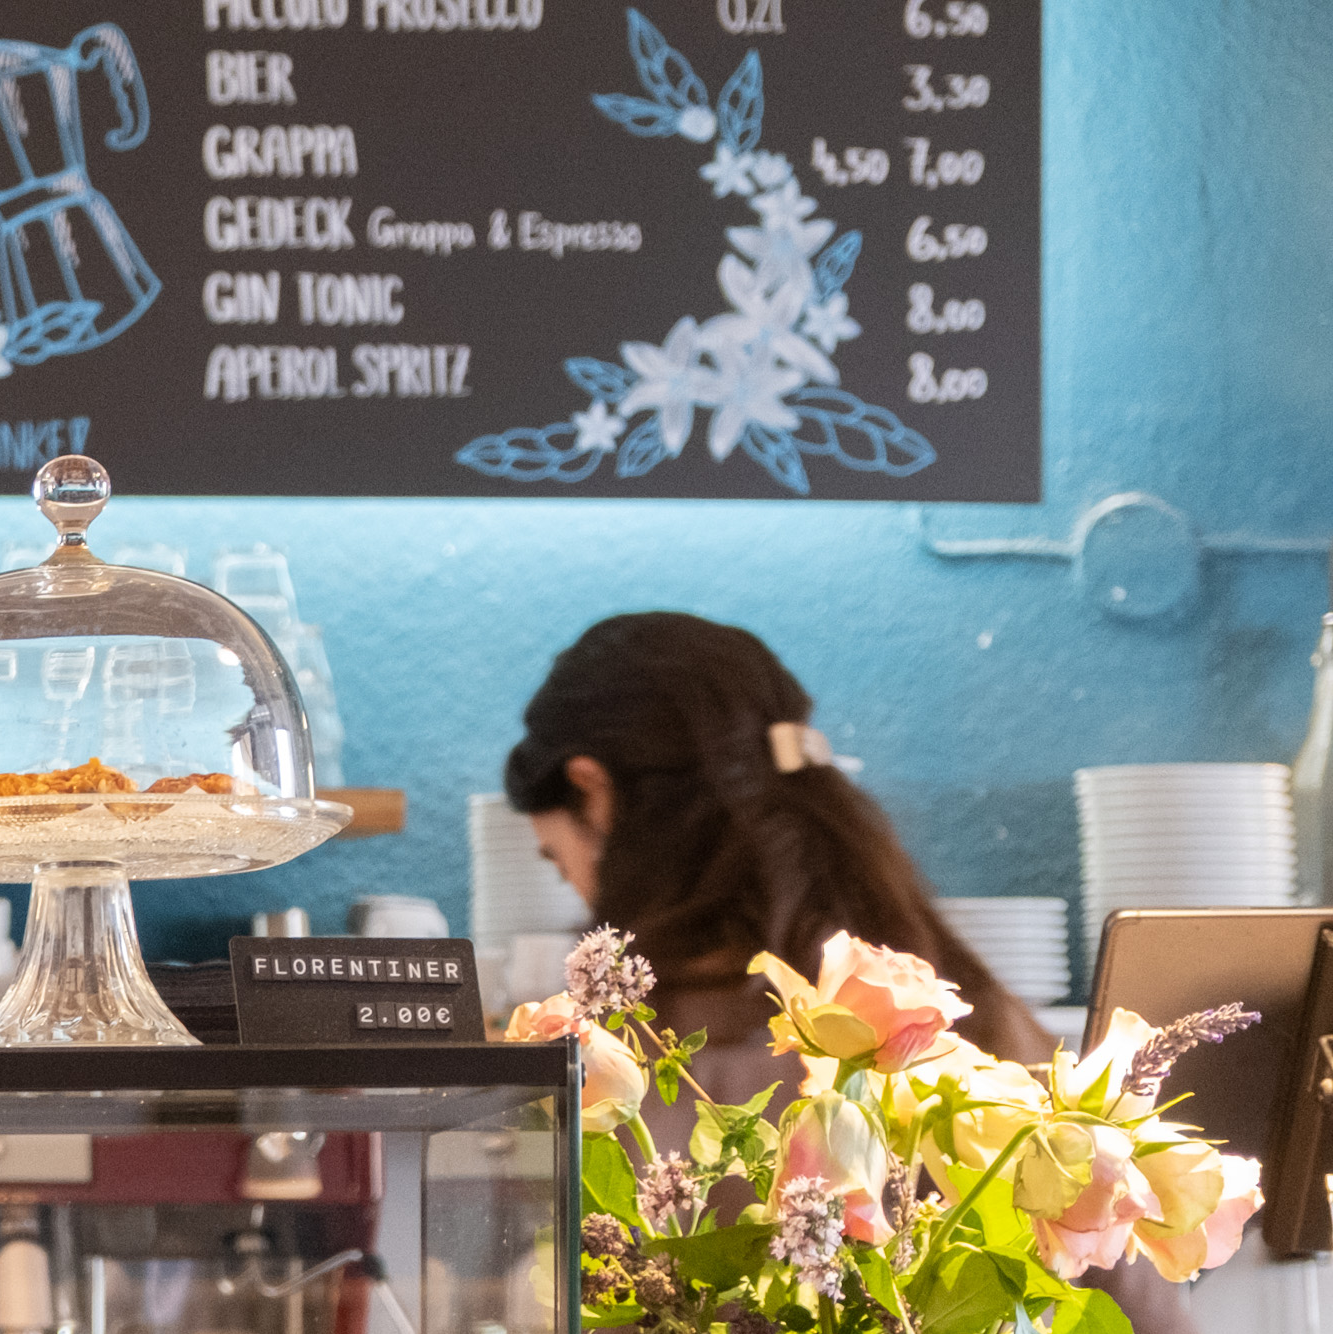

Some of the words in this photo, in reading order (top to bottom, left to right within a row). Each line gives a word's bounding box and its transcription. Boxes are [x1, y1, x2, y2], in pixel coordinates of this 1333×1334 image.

[205, 49, 297, 106] BIER
[202, 124, 359, 180] GRAPPA
[203, 196, 356, 251] GEDECK
[366, 206, 476, 257] Grappa
[486, 207, 512, 252] &
[518, 210, 643, 260] Espresso
[202, 270, 281, 325] GIN
[297, 270, 406, 326] TONIC
[203, 343, 347, 402] APEROL
[350, 343, 473, 400] SPRITZ
[254, 957, 460, 980] FLORENTINER
[359, 1006, 452, 1025] 2,00€
